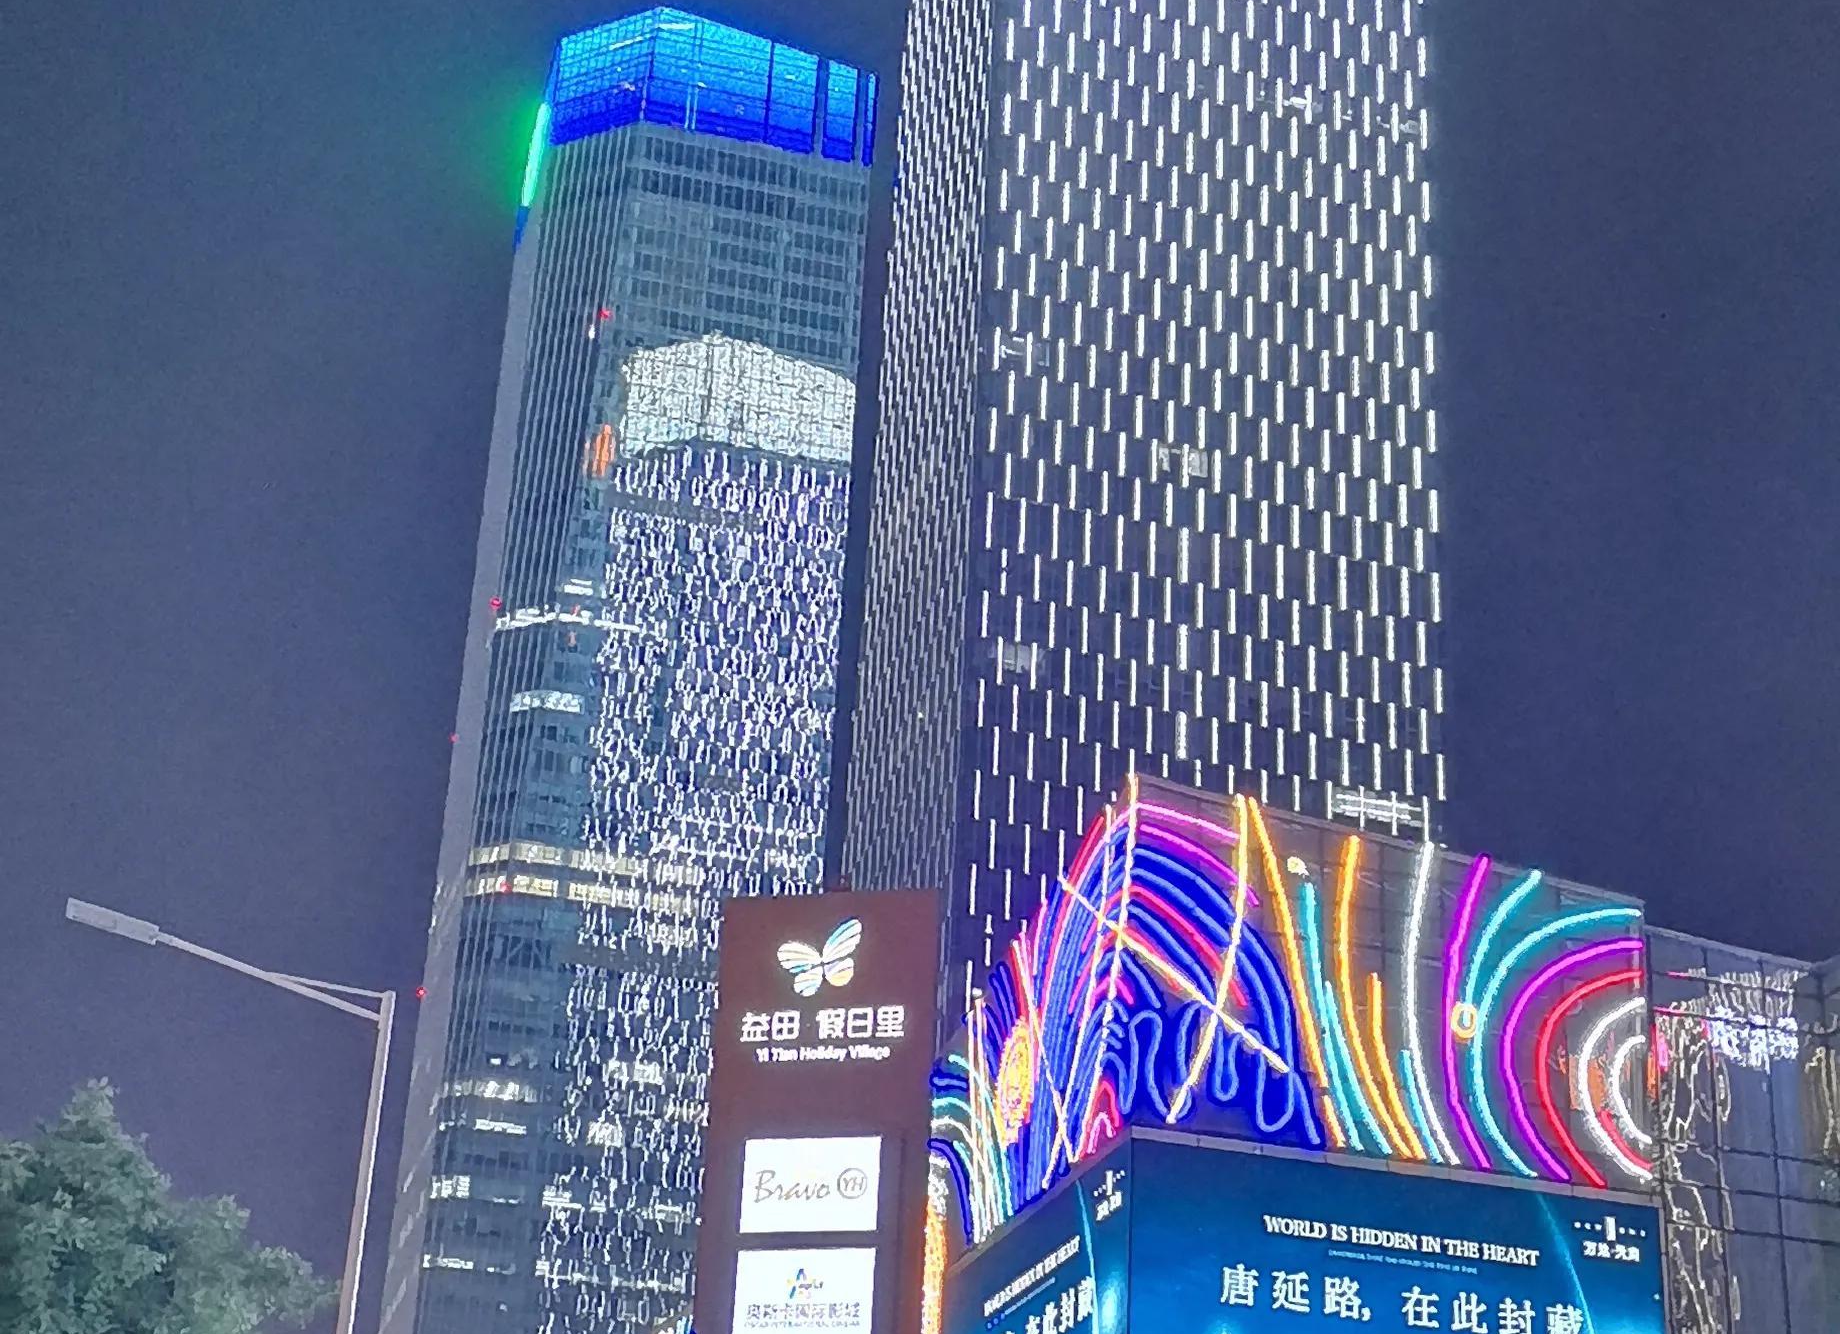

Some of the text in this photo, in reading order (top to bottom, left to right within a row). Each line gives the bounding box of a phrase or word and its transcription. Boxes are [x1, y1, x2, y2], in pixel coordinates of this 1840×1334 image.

[800, 1045, 847, 1062] Holiday
[848, 1043, 891, 1061] Village
[753, 1169, 831, 1204] Bravo
[1262, 1214, 1328, 1240] WORLD
[1330, 1222, 1349, 1242] IS
[1350, 1225, 1419, 1251] HIDDEN
[1420, 1233, 1442, 1254] IN
[1443, 1237, 1480, 1260] THE
[1482, 1242, 1540, 1267] HEART
